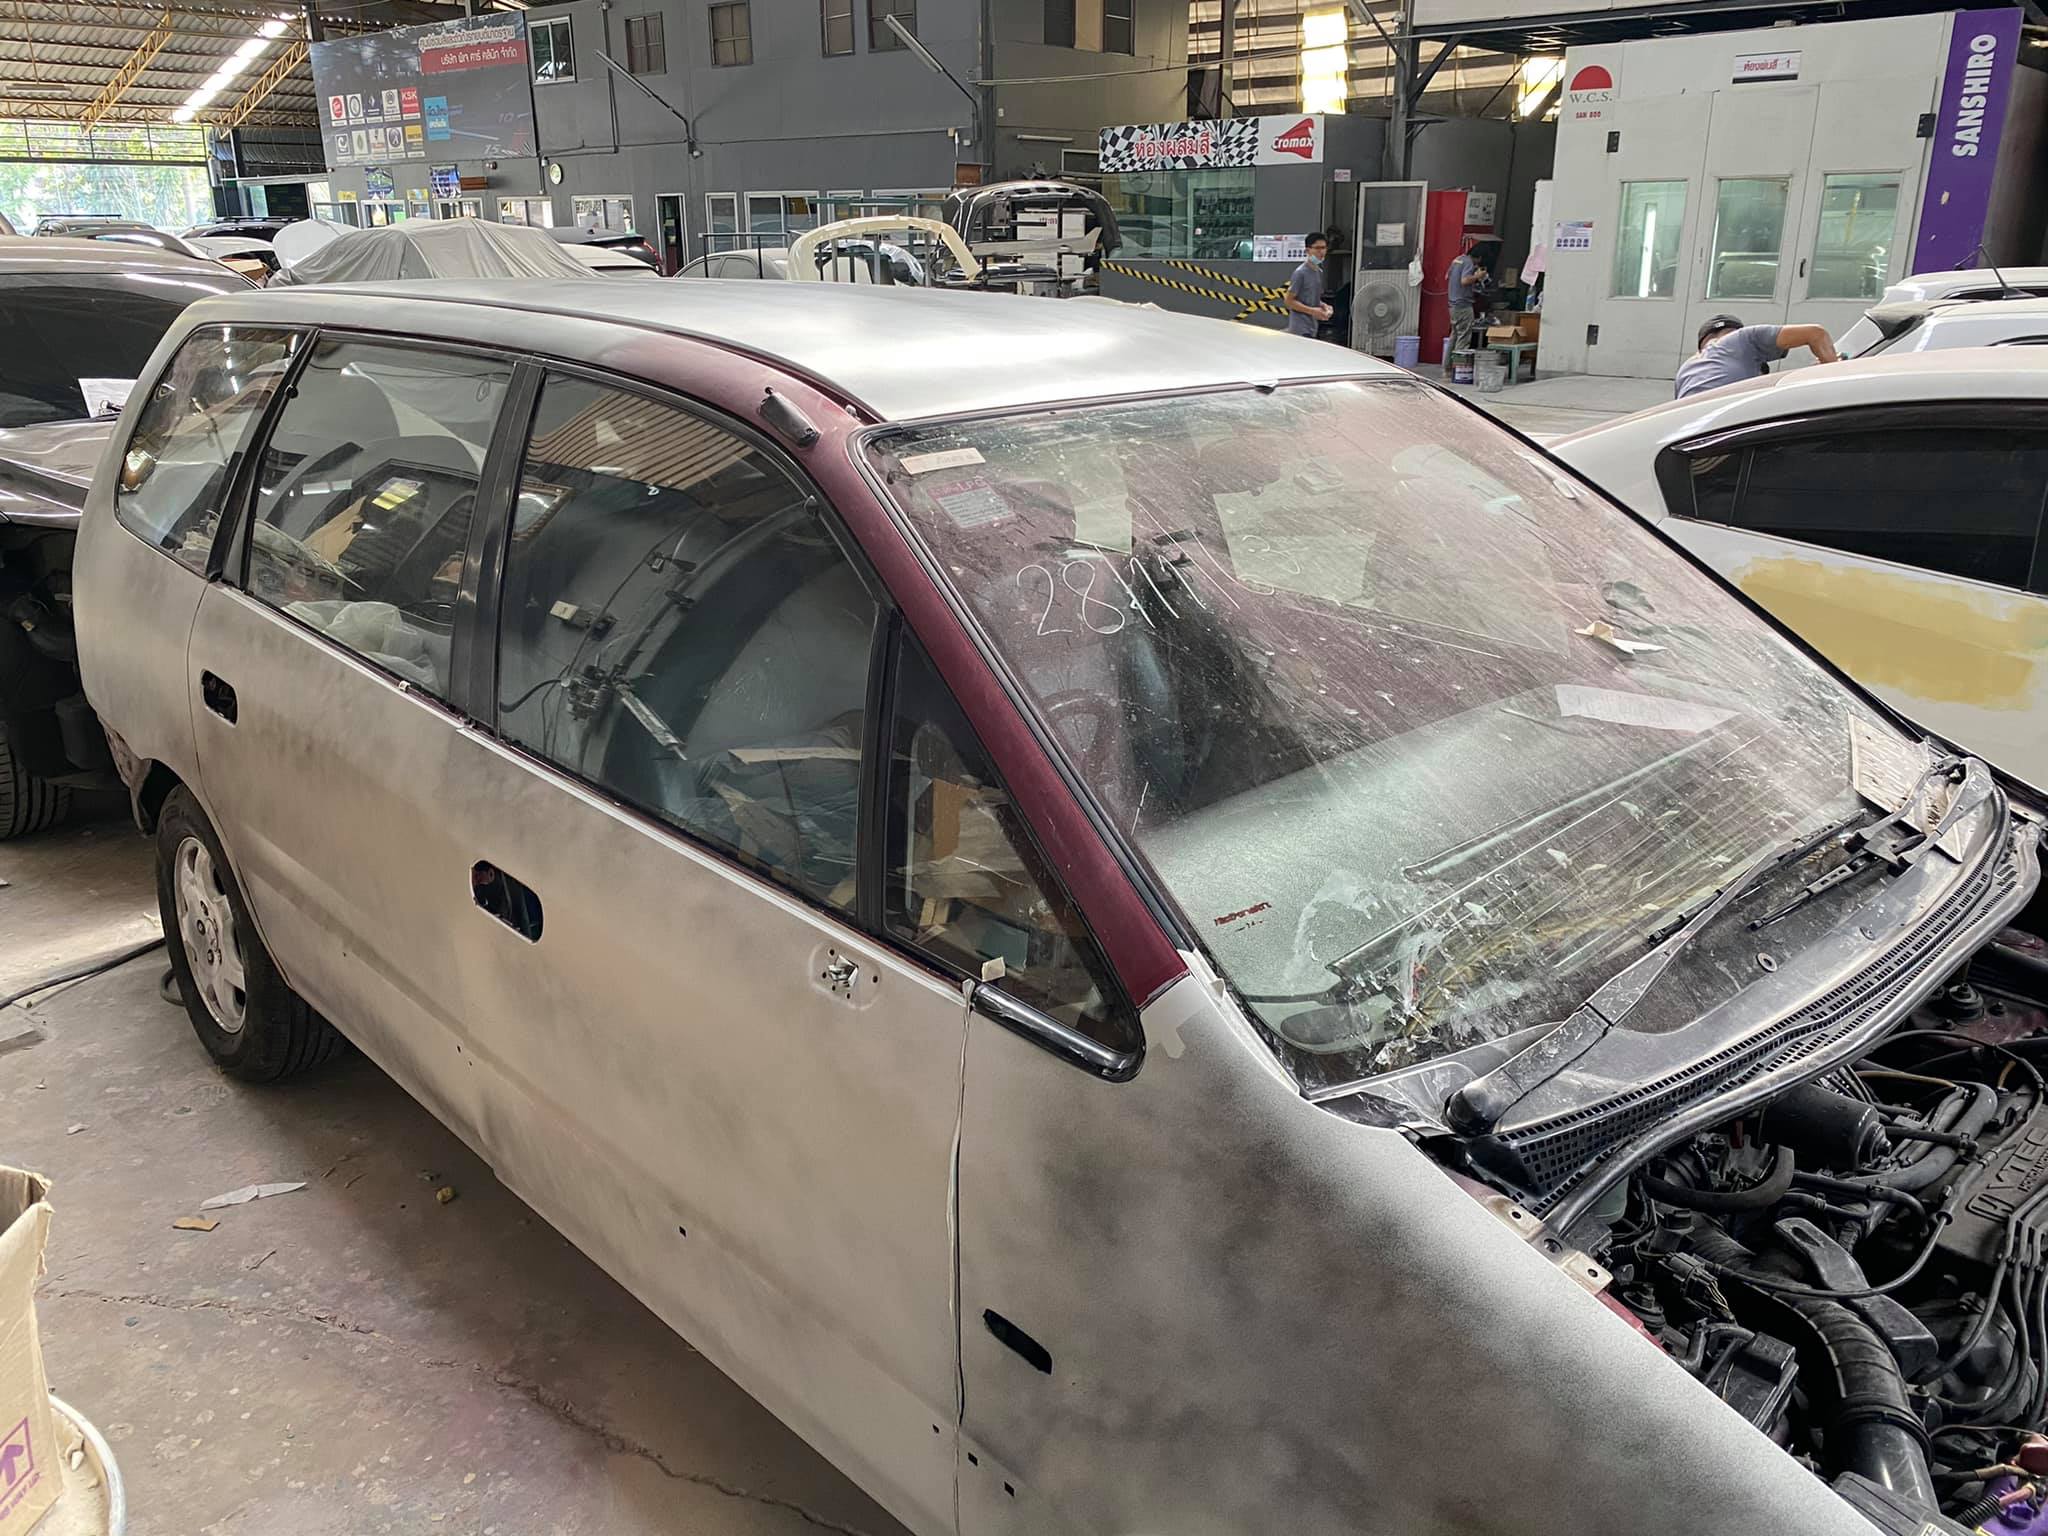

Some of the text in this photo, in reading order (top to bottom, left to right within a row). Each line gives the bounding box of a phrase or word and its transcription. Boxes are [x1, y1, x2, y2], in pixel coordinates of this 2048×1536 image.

[1569, 91, 1613, 103] W.C.S.
[1952, 34, 1997, 157] SANSHIRO
[1134, 132, 1210, 159] ห้องผสมสี
[1271, 136, 1313, 150] Cromax
